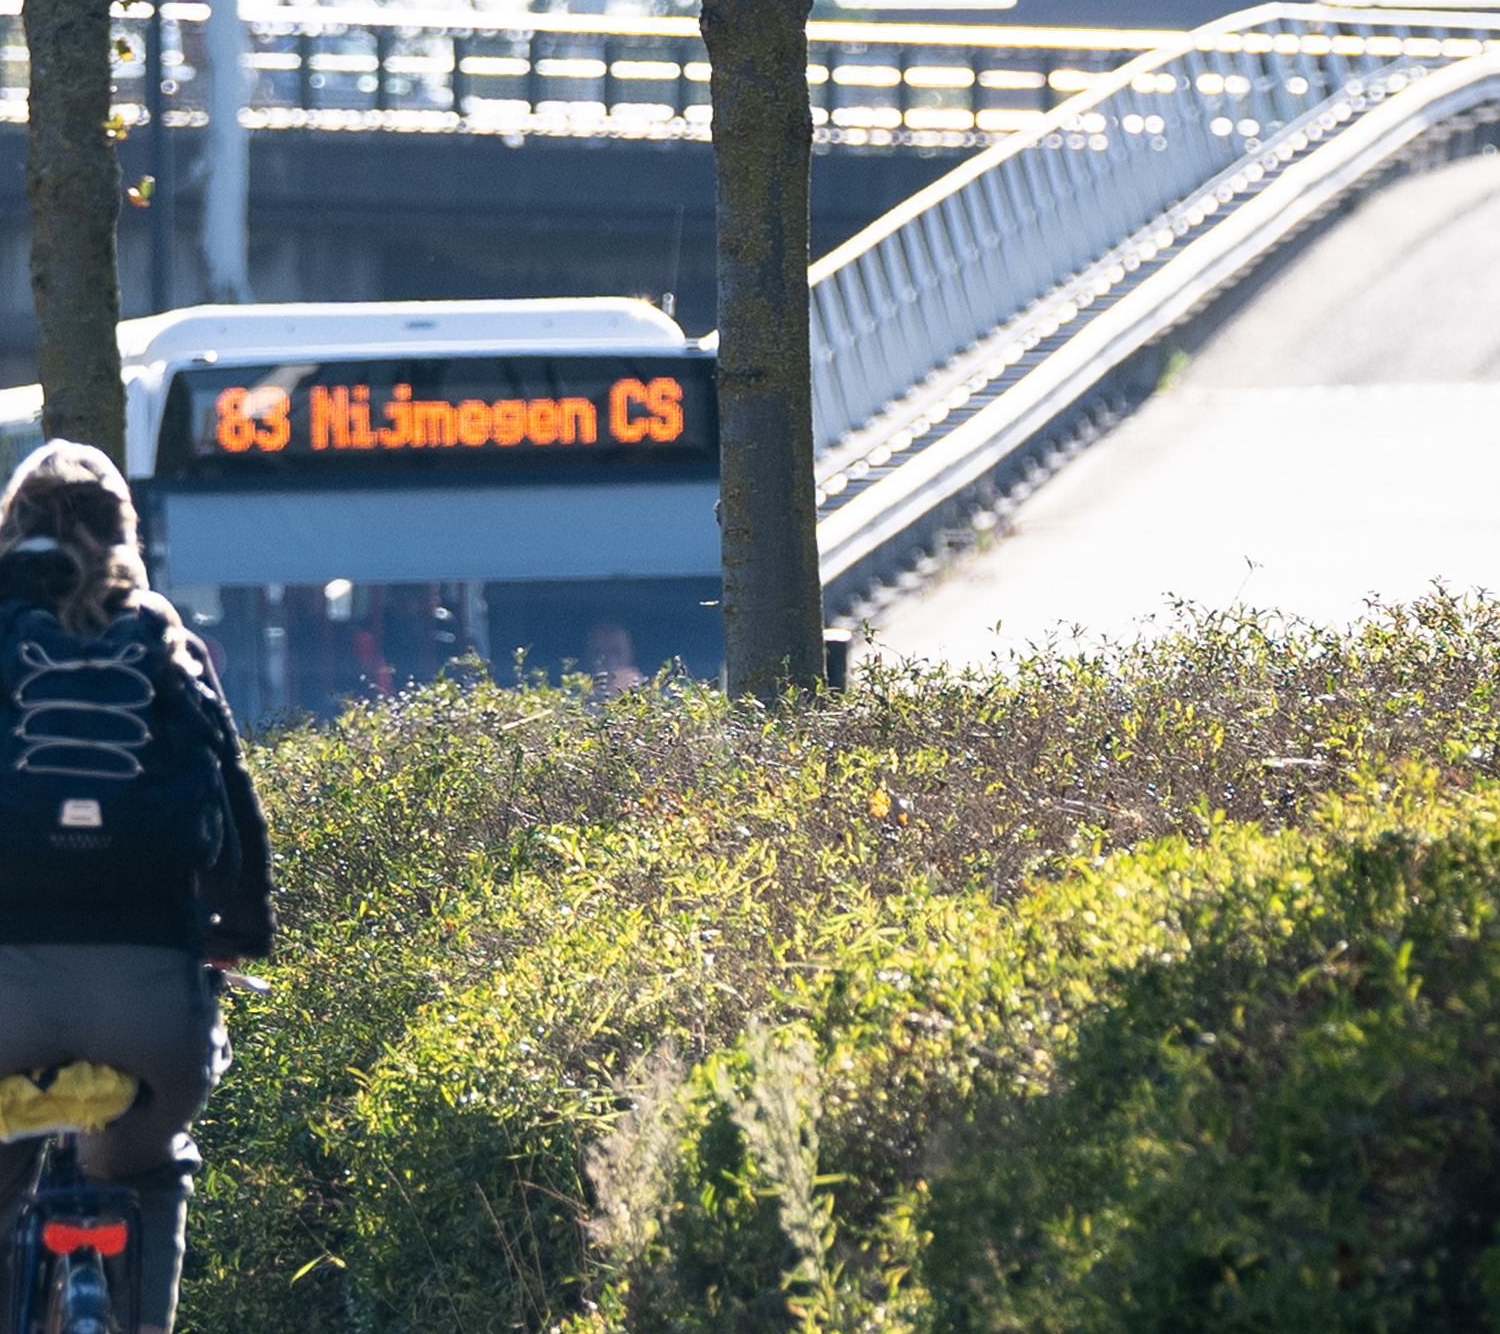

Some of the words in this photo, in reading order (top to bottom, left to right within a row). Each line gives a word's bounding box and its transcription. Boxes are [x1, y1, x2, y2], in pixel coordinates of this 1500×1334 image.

[216, 385, 291, 452] 83
[309, 382, 598, 451] Nijmegen
[608, 376, 684, 444] CS
